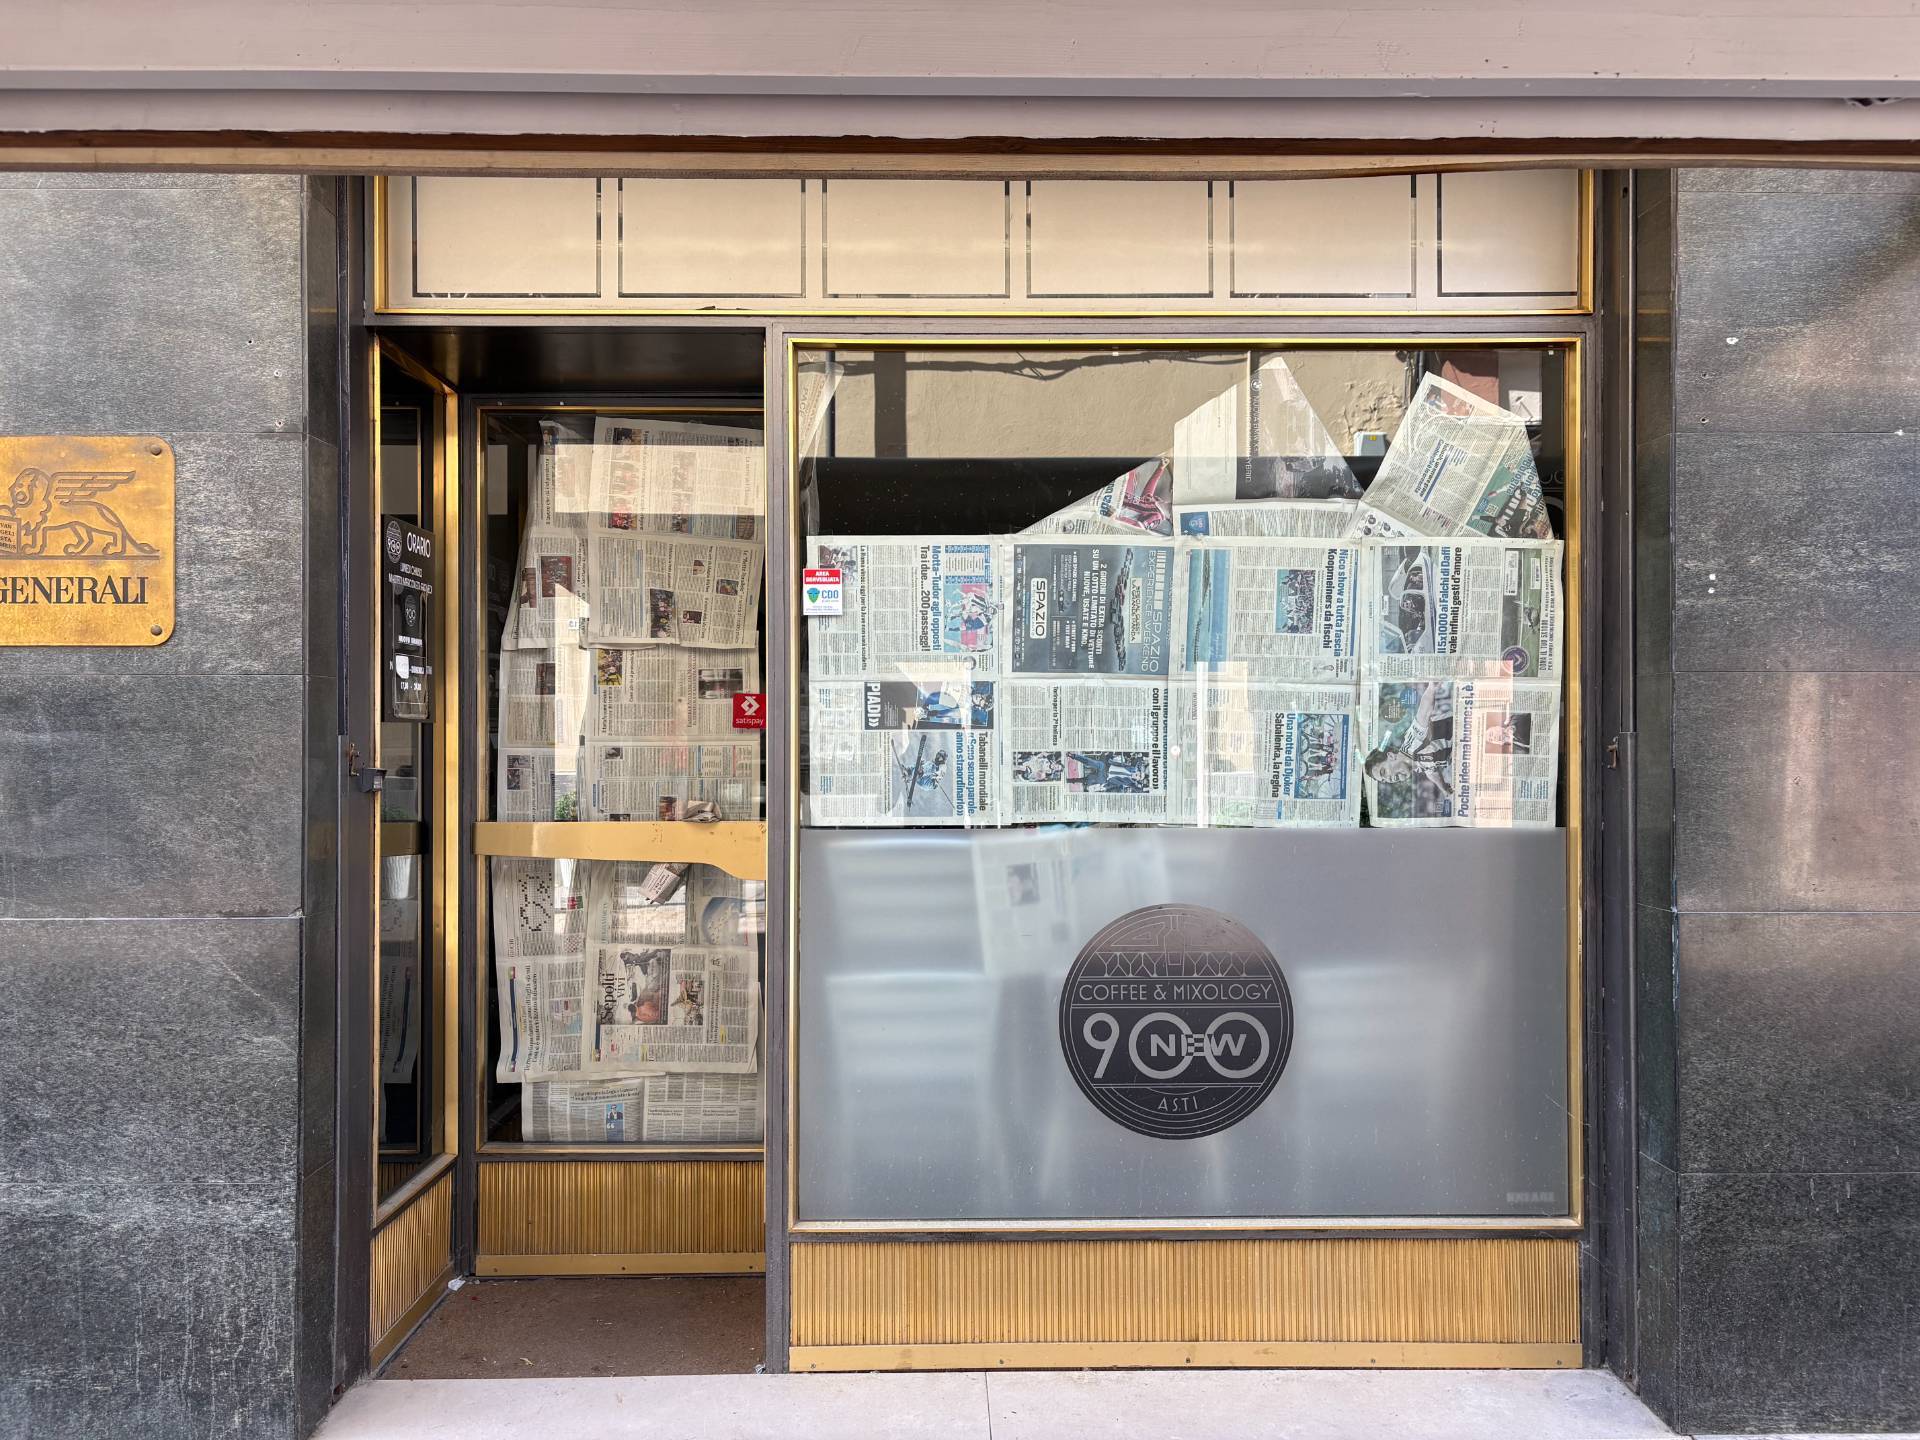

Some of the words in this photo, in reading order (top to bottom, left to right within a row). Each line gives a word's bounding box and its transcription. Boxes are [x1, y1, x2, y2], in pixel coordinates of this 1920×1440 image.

[407, 532, 431, 558] ORARIO
[921, 545, 930, 559] Tra
[1093, 550, 1099, 559] SU
[1093, 561, 1099, 570] UN
[1338, 548, 1349, 570] Nico
[1451, 547, 1462, 584] d'amore
[932, 545, 941, 600] Motta-Tudor
[1145, 550, 1156, 617] EXPERIENCE
[1325, 548, 1337, 609] Koopmeiners
[1338, 571, 1348, 596] show
[1440, 568, 1450, 577] di
[921, 590, 930, 609] 200
[1439, 577, 1449, 603] Falchi
[1450, 584, 1461, 606] gesti
[931, 601, 941, 617] agli
[1035, 580, 1046, 636] SPAZIO
[1090, 596, 1098, 628] LIMITATO
[1324, 611, 1334, 621] da
[1335, 605, 1346, 628] tutta
[1439, 604, 1448, 612] ai
[1449, 606, 1460, 635] infiniti
[920, 610, 930, 652] passaggi!
[931, 618, 941, 651] opposti
[1150, 611, 1162, 672] SPAZIO
[1323, 623, 1334, 649] fischi
[1334, 629, 1345, 657] fascia
[1438, 613, 1448, 647] 5x1000
[1141, 620, 1151, 672] WEEKEND
[1449, 635, 1457, 654] vale
[1152, 688, 1160, 704] con
[736, 718, 764, 726] satispay
[1151, 711, 1160, 742] gruppo
[1286, 713, 1296, 730] Una
[1460, 707, 1472, 743] buone:
[956, 731, 964, 753] anno
[1273, 712, 1284, 761] Sabalenka,
[1285, 731, 1294, 755] notte
[979, 731, 989, 770] Tabanelli
[1285, 756, 1294, 767] da
[1461, 744, 1471, 761] ma
[968, 761, 976, 786] senza
[1273, 762, 1282, 770] la
[1459, 762, 1470, 784] idee
[956, 754, 965, 816] straordinario»
[979, 771, 989, 811] mondiale
[1271, 770, 1281, 798] regina
[1283, 768, 1293, 796] Djoker
[1458, 785, 1470, 818] Poche
[600, 973, 617, 1022] Sepolti
[615, 977, 625, 998] vivi
[1079, 984, 1147, 1000] COFFEE
[1153, 984, 1167, 1000] &
[1174, 983, 1272, 1000] MIXOLOGY
[1083, 1012, 1270, 1079] 900
[1151, 1034, 1247, 1057] NEW
[1158, 1096, 1198, 1112] ASTI
